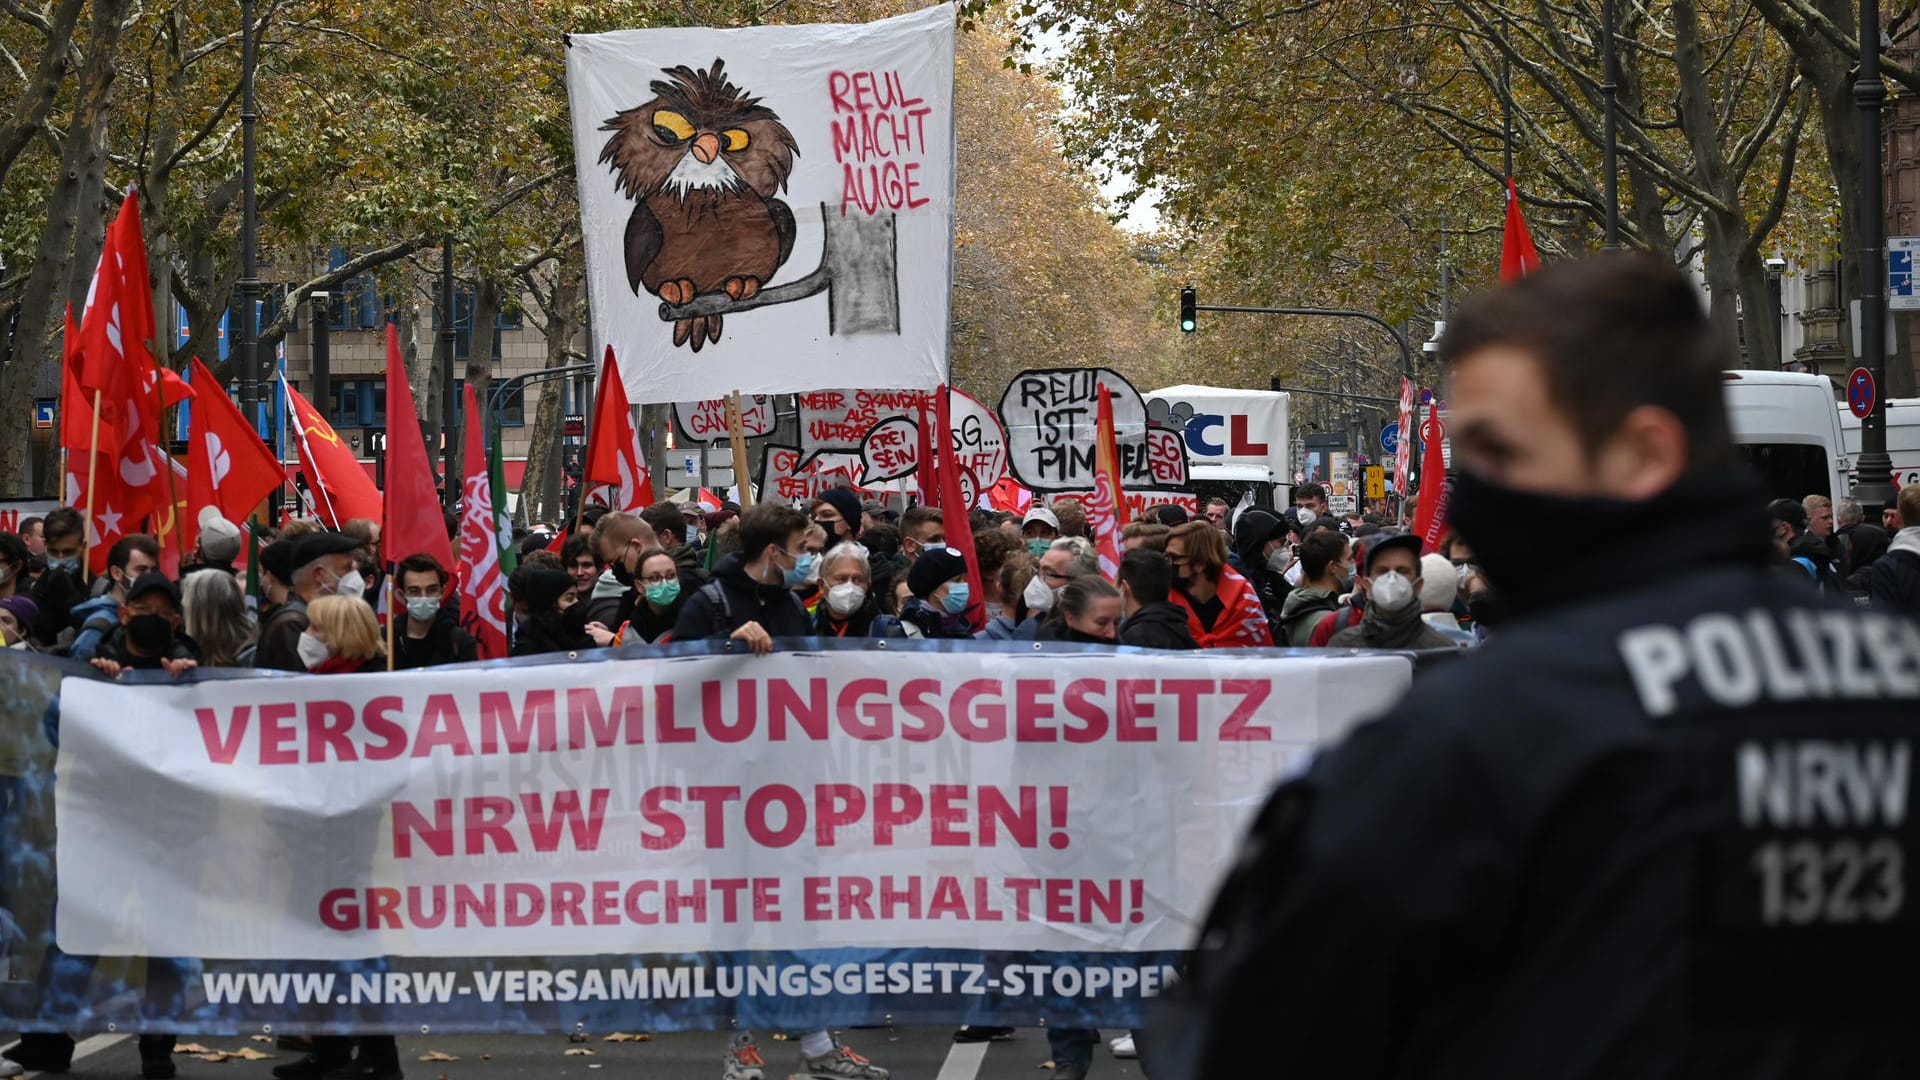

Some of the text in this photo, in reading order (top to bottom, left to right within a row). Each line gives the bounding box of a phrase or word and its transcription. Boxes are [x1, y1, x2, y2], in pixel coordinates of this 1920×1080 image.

[828, 70, 923, 113] REUL
[831, 105, 932, 163] MACHT
[841, 160, 930, 216] AUGE
[800, 390, 937, 414] MEHR SKANDAE
[1021, 372, 1121, 409] REUL
[690, 407, 767, 434] GANE!
[844, 408, 879, 426] ALS
[869, 430, 906, 451] FREI
[1034, 408, 1088, 446] IST
[872, 443, 916, 469] SEIN
[1618, 609, 1920, 716] POLIZE
[196, 678, 1273, 765] VERSAMMLUNGSGESETZ
[1737, 741, 1911, 828] NRW
[393, 788, 610, 859] NRW
[641, 783, 1070, 850] STOPPEN!
[319, 876, 1144, 931] GRUNDRECHTE ERHALTEN!
[1756, 841, 1904, 924] 1323
